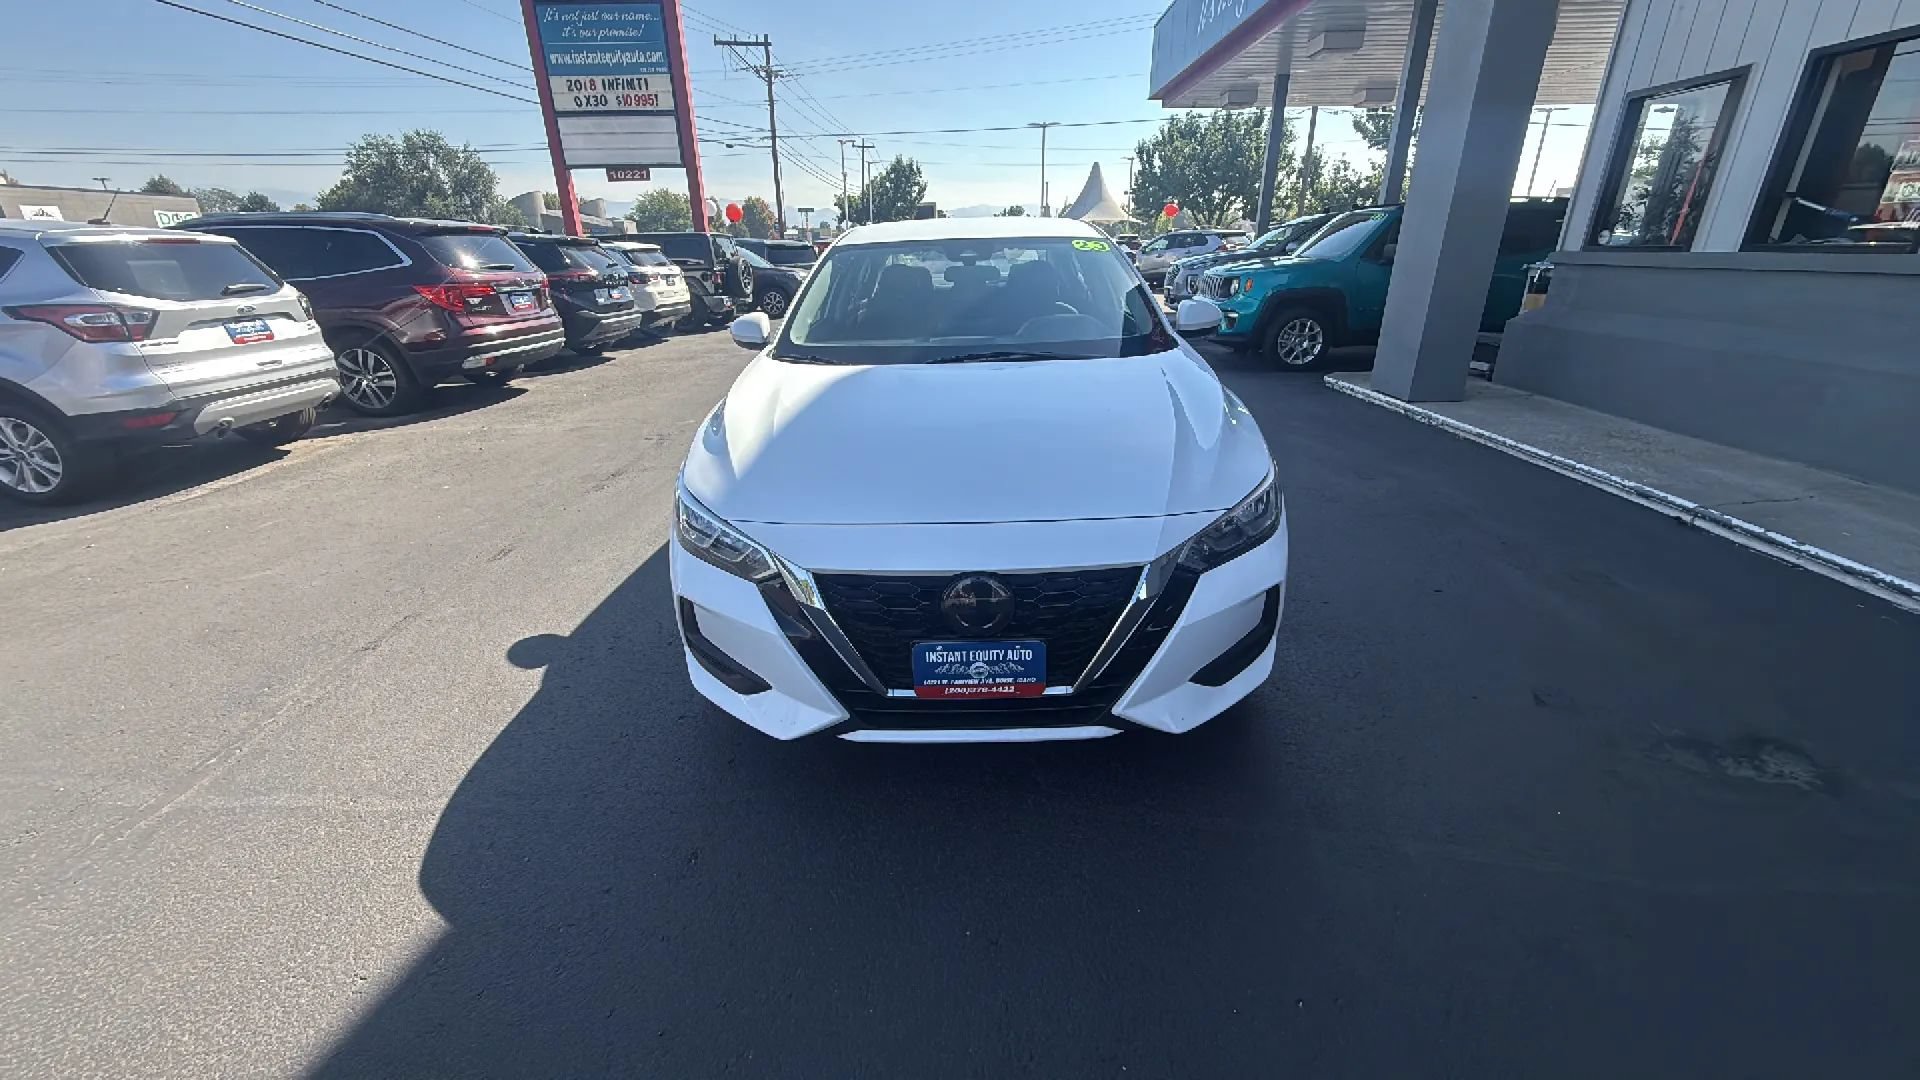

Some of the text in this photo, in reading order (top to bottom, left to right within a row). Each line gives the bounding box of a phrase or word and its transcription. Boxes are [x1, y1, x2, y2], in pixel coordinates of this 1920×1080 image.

[561, 9, 579, 21] not
[601, 11, 620, 21] our
[579, 29, 597, 38] our
[550, 49, 664, 67] www.instantequityauto.com
[566, 78, 597, 92] 2018
[609, 170, 647, 179] 10221
[925, 648, 1034, 663] INSTANT EQUITY AUTO
